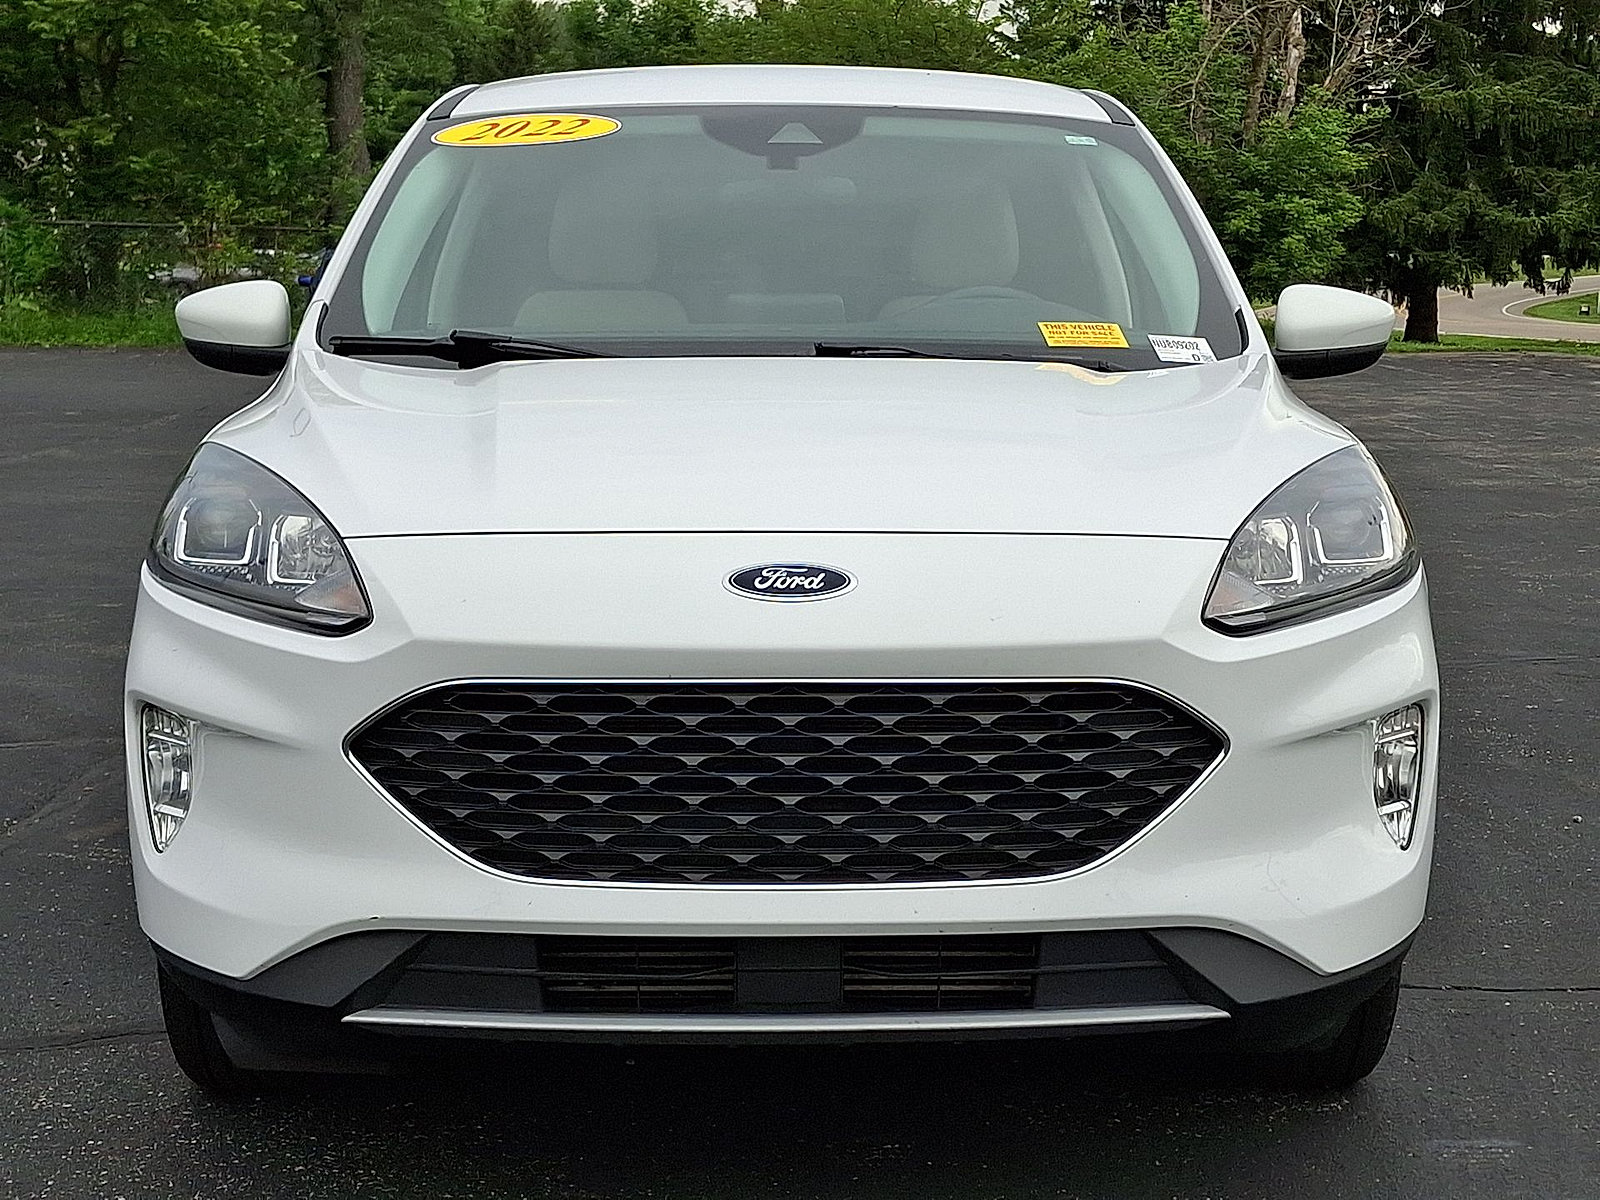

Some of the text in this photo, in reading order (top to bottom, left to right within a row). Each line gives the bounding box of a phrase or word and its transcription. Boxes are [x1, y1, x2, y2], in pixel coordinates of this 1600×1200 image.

[459, 119, 592, 142] 2022
[1043, 323, 1115, 332] THIS VEHICLE
[754, 567, 826, 590] Ford
